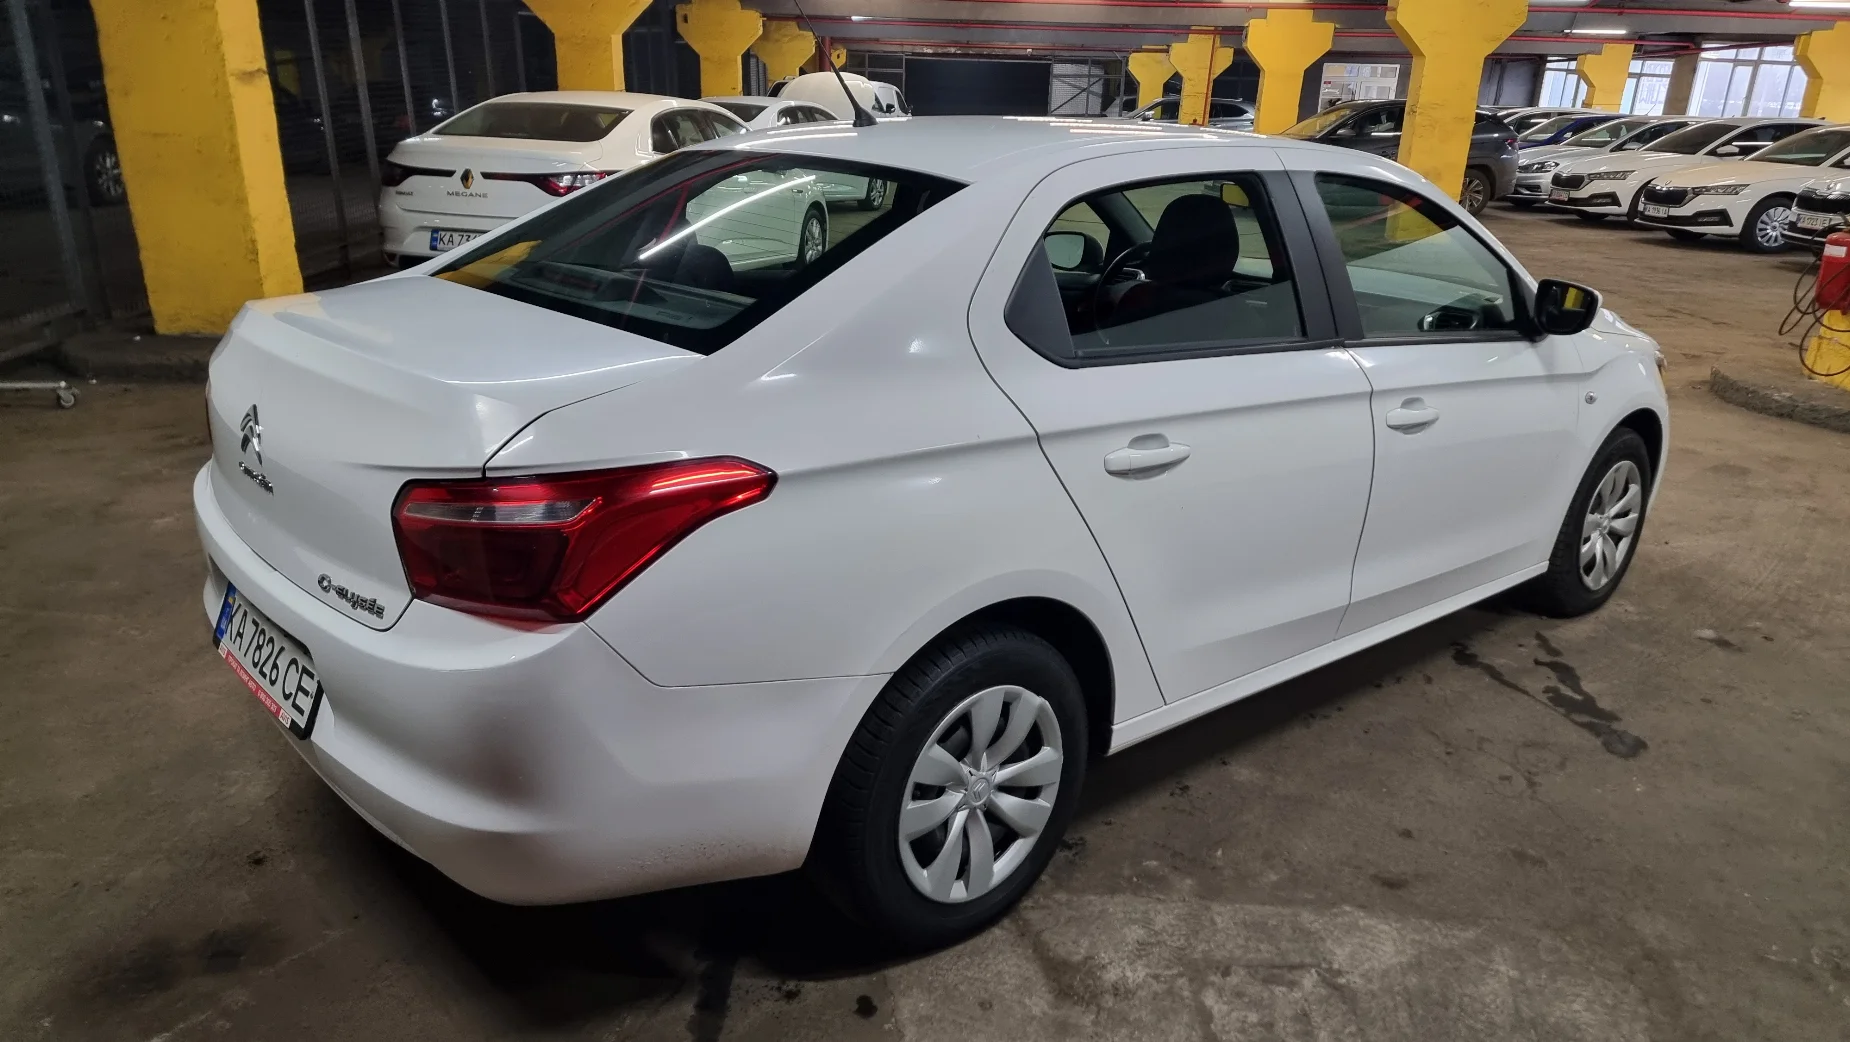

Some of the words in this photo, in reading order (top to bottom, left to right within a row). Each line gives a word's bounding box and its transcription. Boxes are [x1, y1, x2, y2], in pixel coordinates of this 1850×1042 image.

[446, 190, 489, 199] MEGANE
[438, 232, 454, 246] KA
[225, 596, 248, 653] KA
[243, 617, 286, 688] 7826
[281, 656, 316, 718] CE
